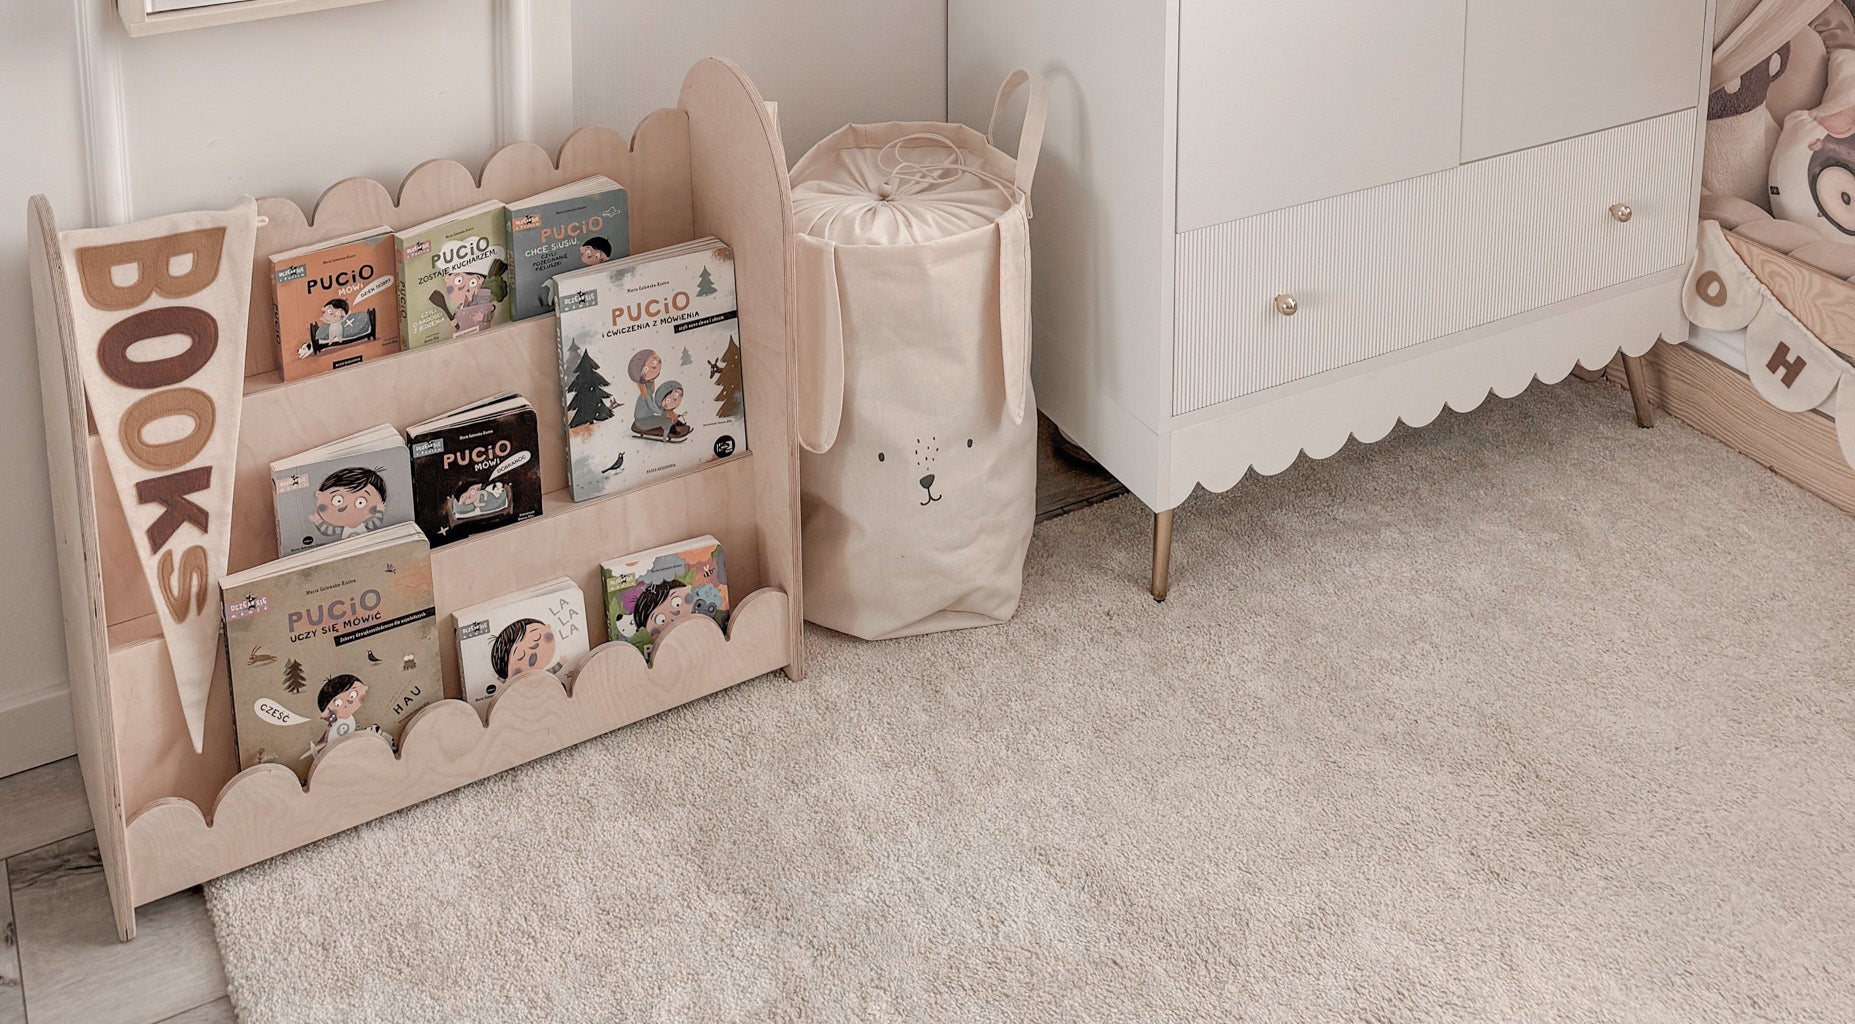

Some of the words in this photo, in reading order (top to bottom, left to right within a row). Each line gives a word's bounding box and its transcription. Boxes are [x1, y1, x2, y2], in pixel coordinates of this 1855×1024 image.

[524, 244, 549, 258] CHCE
[418, 268, 450, 285] ZOSTAJE
[652, 319, 658, 329] Z
[74, 226, 227, 625] BOOKS
[548, 598, 570, 617] LA
[557, 608, 580, 627] LA
[290, 629, 318, 643] UCZY
[558, 623, 580, 641] LA
[392, 685, 421, 715] HAU
[260, 703, 290, 723] CZEŚĆ
